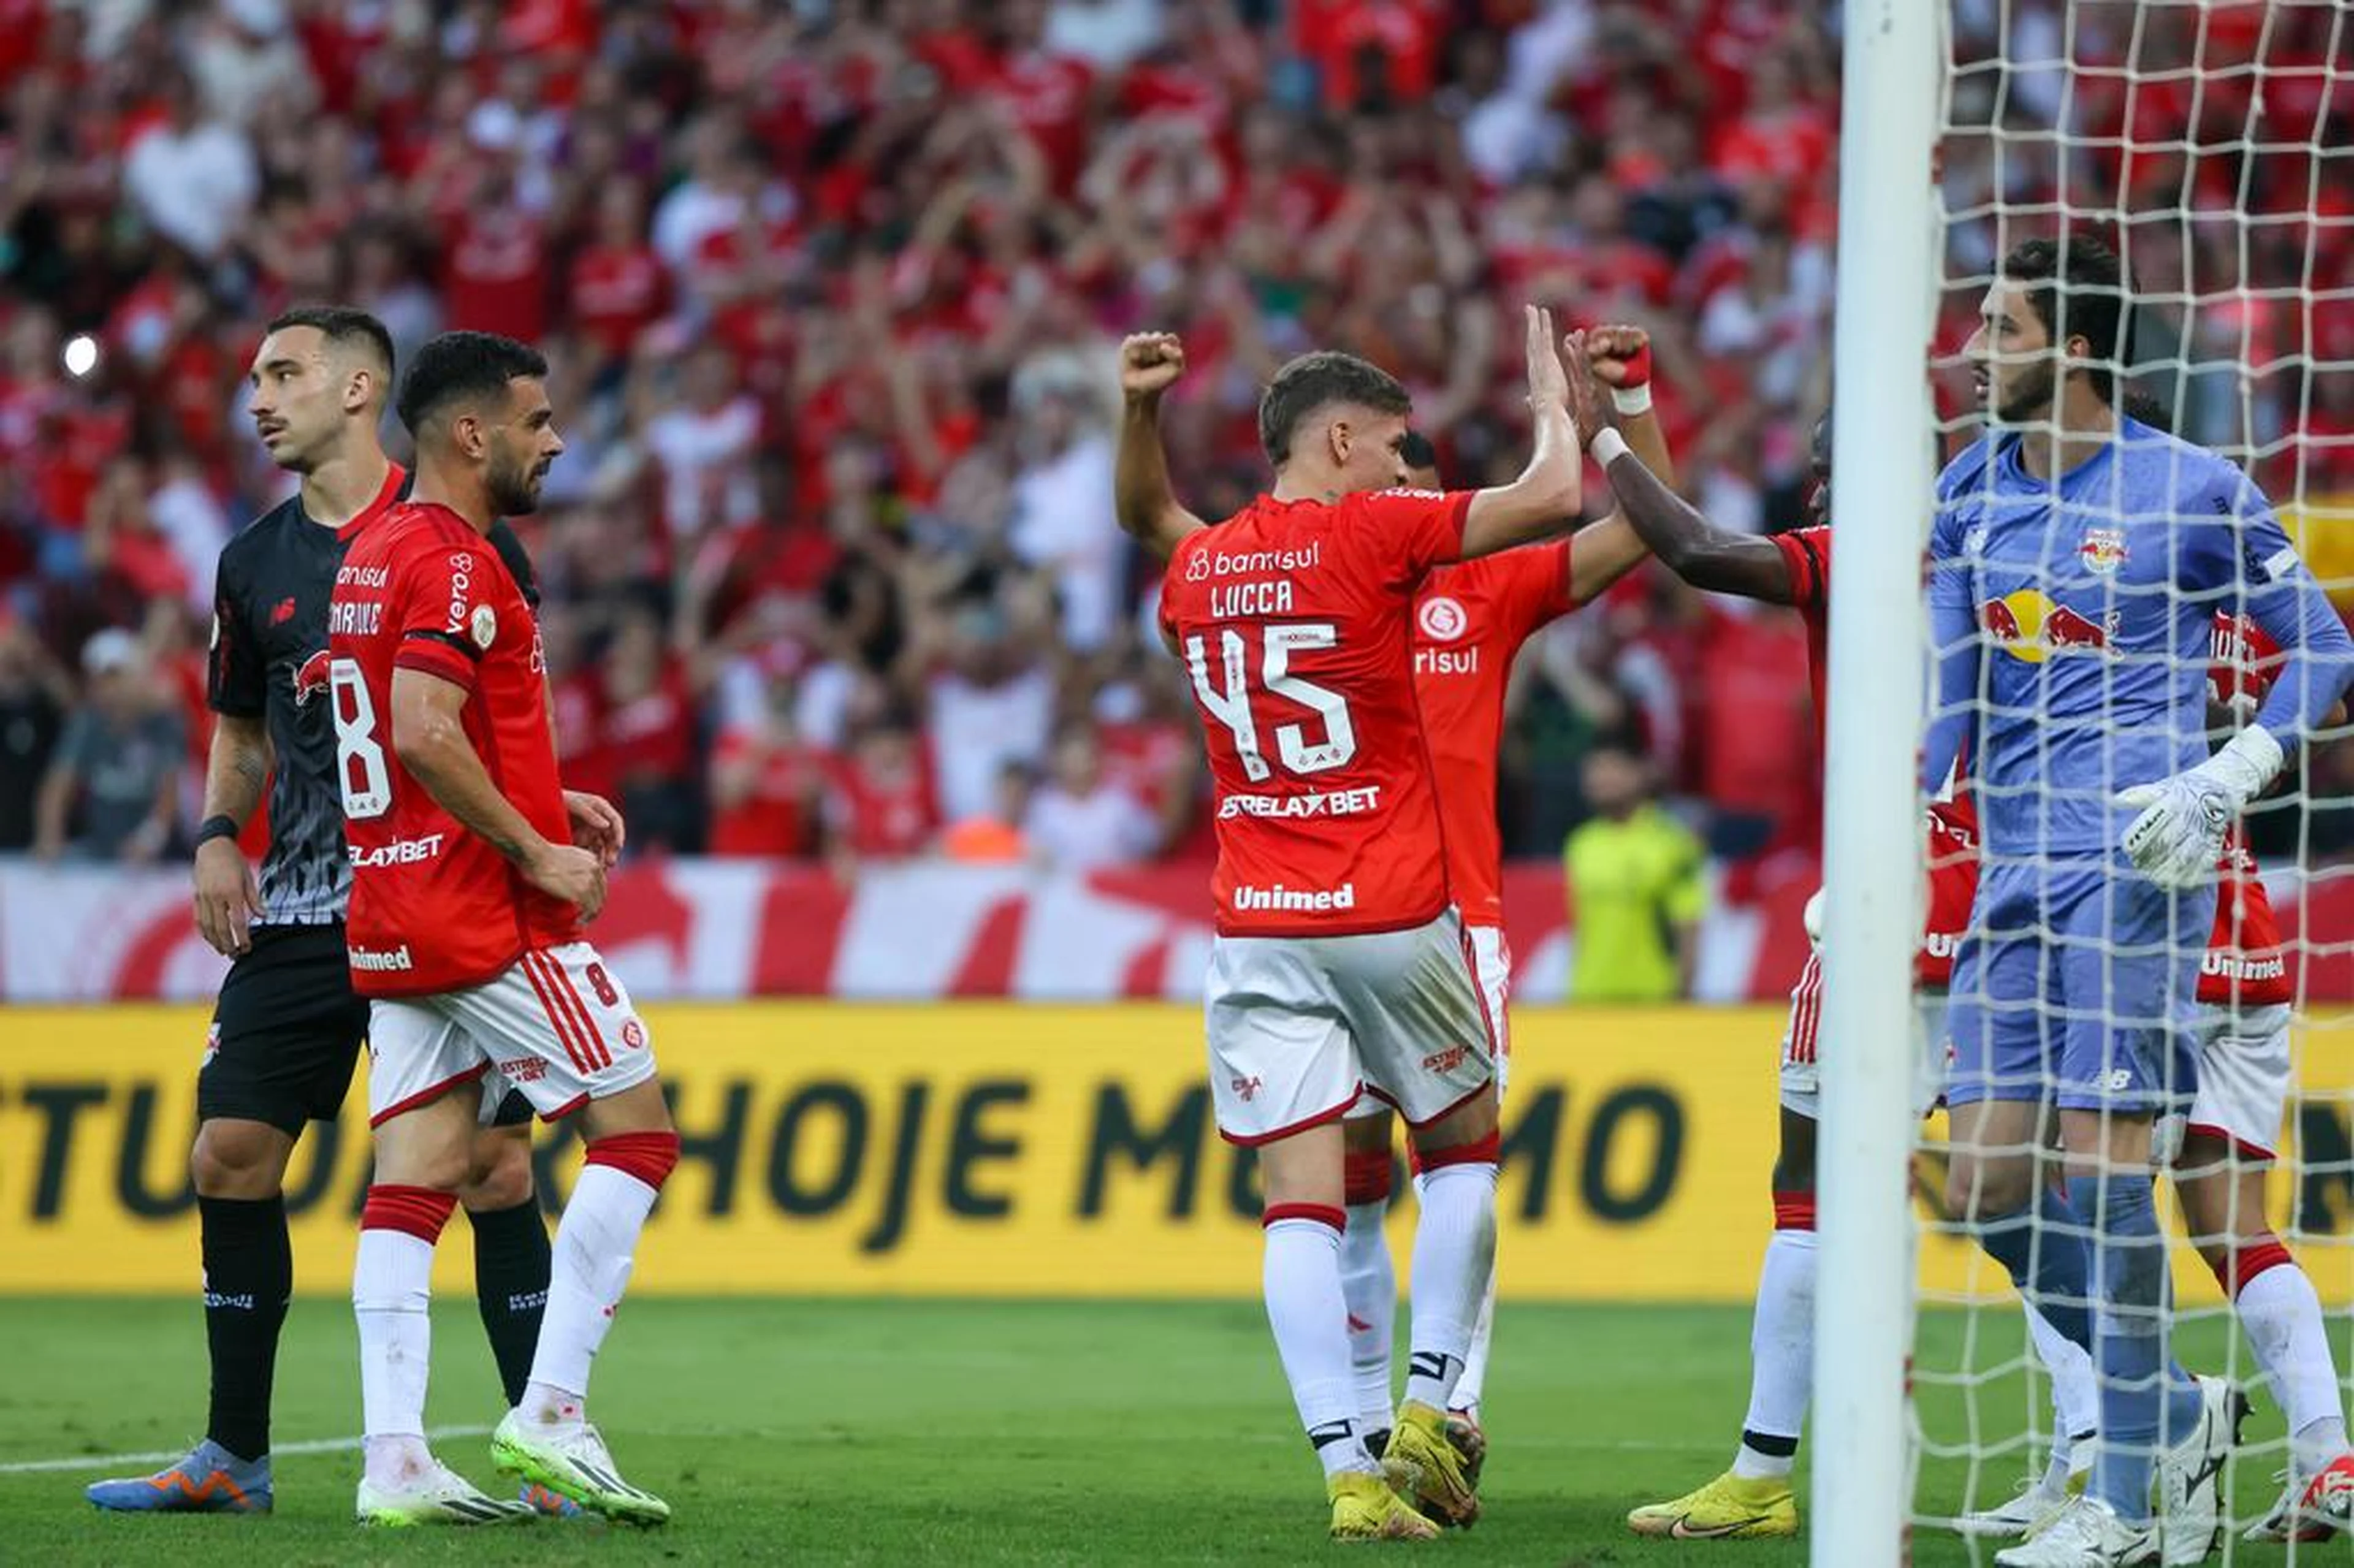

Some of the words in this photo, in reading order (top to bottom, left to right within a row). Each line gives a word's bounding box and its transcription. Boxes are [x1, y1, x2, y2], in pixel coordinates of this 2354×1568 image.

[446, 573, 469, 635] vero
[1211, 580, 1293, 617] LUCCA
[1186, 624, 1357, 782] 45
[330, 658, 392, 820] 8
[1234, 882, 1354, 910] Unimed
[347, 945, 413, 971] nimed
[585, 962, 619, 1007] 8
